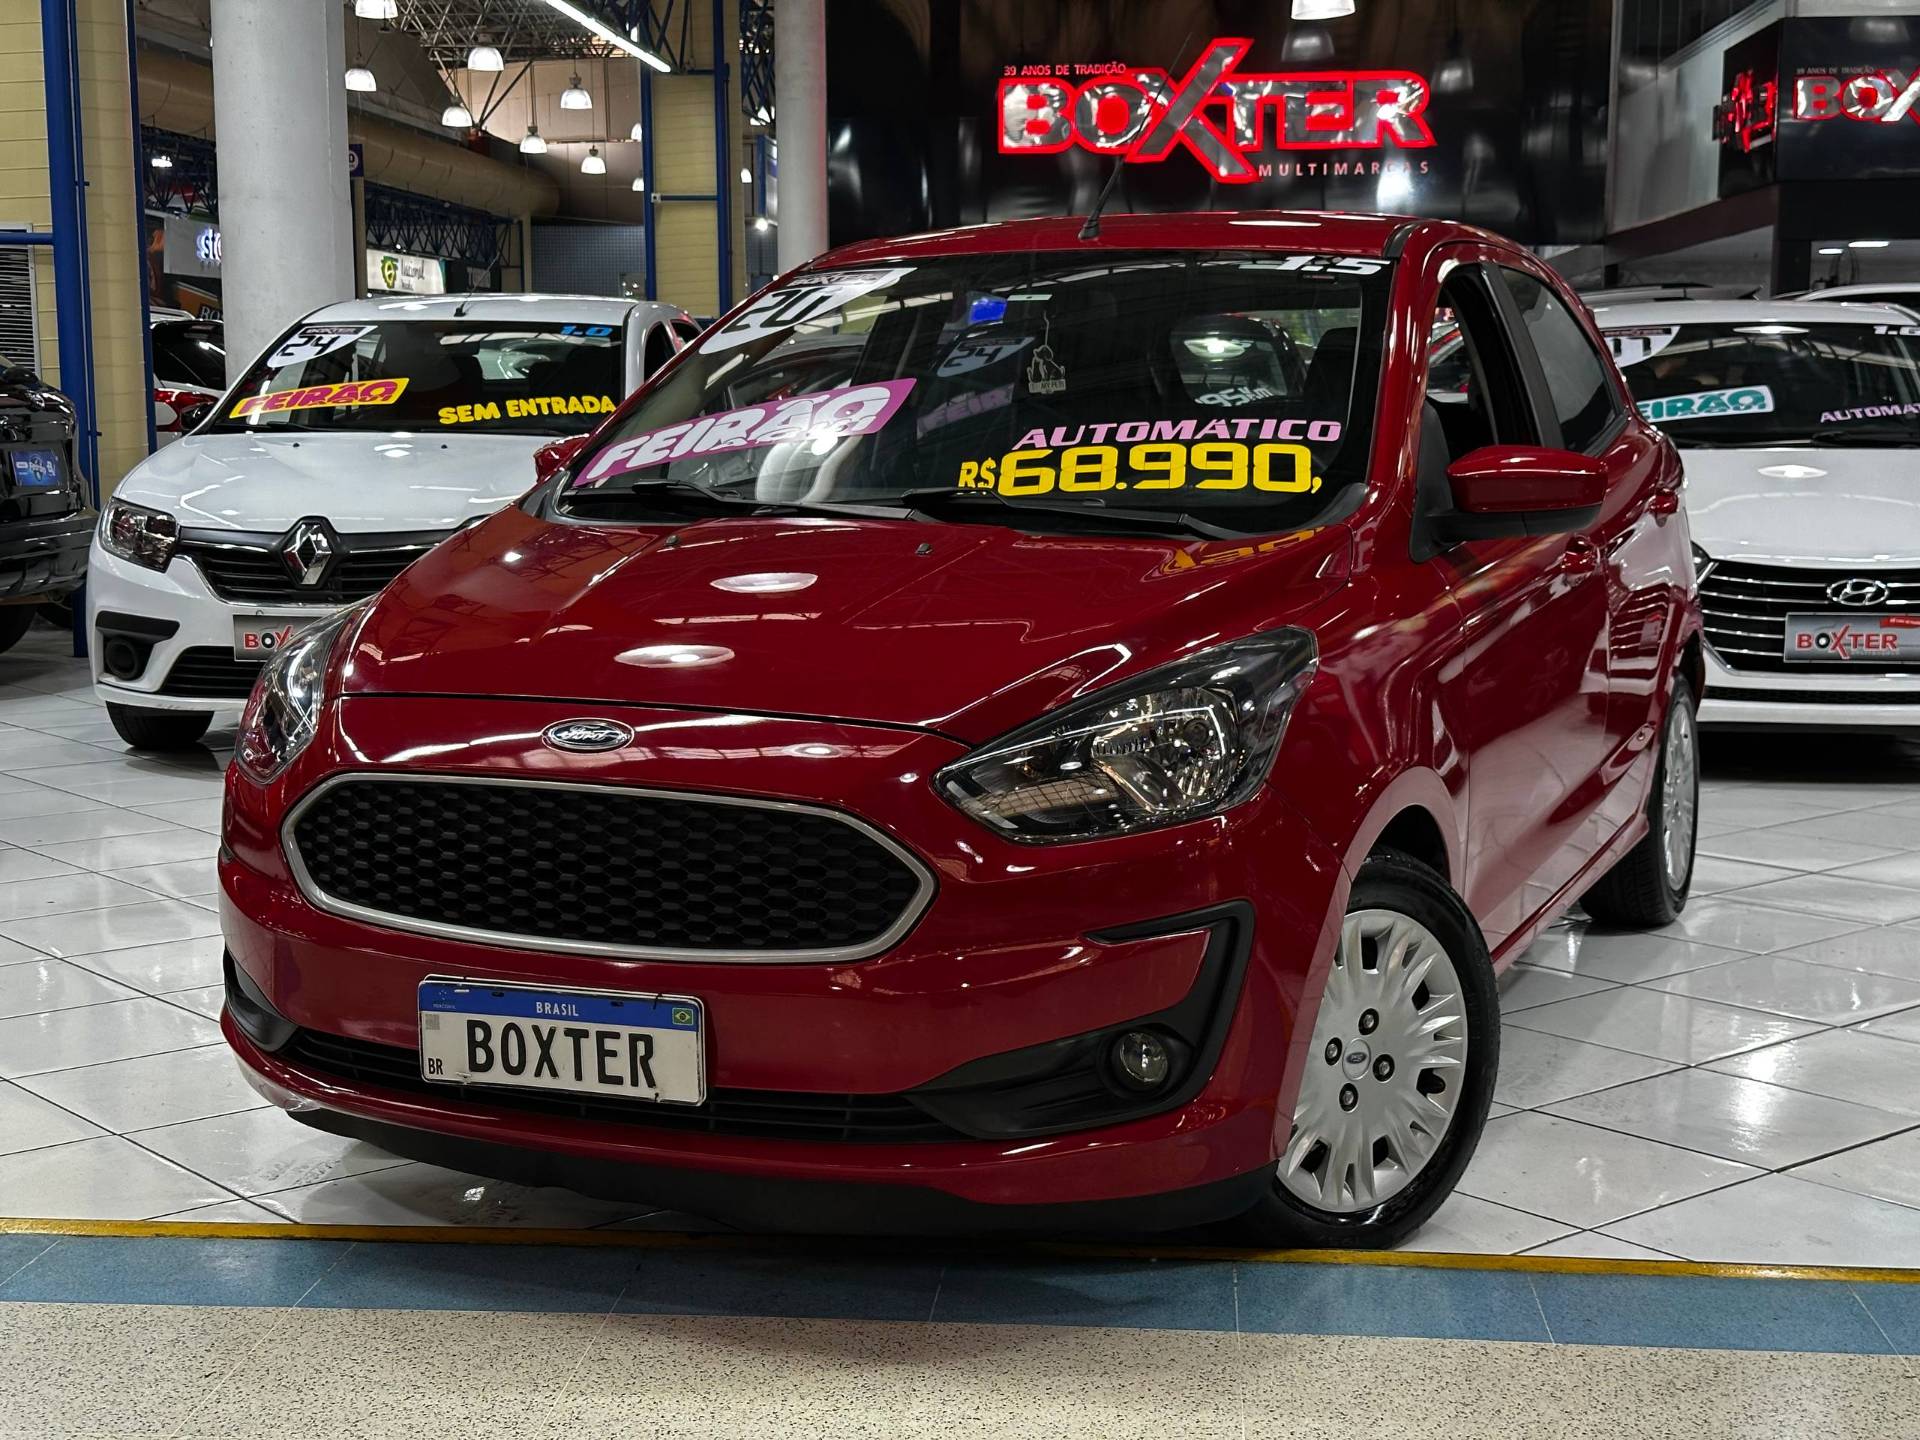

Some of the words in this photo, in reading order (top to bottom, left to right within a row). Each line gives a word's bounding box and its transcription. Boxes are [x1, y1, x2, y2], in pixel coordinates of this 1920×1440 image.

[1003, 65, 1017, 77] 39
[1020, 64, 1051, 76] ANOS
[1055, 64, 1070, 76] DE
[1074, 61, 1127, 76] TRADIÇÃO
[998, 37, 1438, 184] BOXTER
[1258, 160, 1430, 178] MULTIMARCAS
[1276, 256, 1391, 275] 1.5
[721, 287, 833, 335] 20
[276, 335, 341, 357] 24
[560, 325, 613, 337] 1.0
[239, 381, 398, 415] FEIRÃO
[438, 402, 501, 425] SEM
[505, 395, 617, 418] ENTRADA
[586, 387, 891, 480] FEIRÃO
[957, 457, 996, 490] R$
[997, 442, 1322, 496] 68.990,
[1796, 623, 1899, 660] BOXTER
[535, 1001, 579, 1016] BRASIL
[428, 1057, 443, 1076] BR
[467, 1019, 657, 1089] BOXTER
